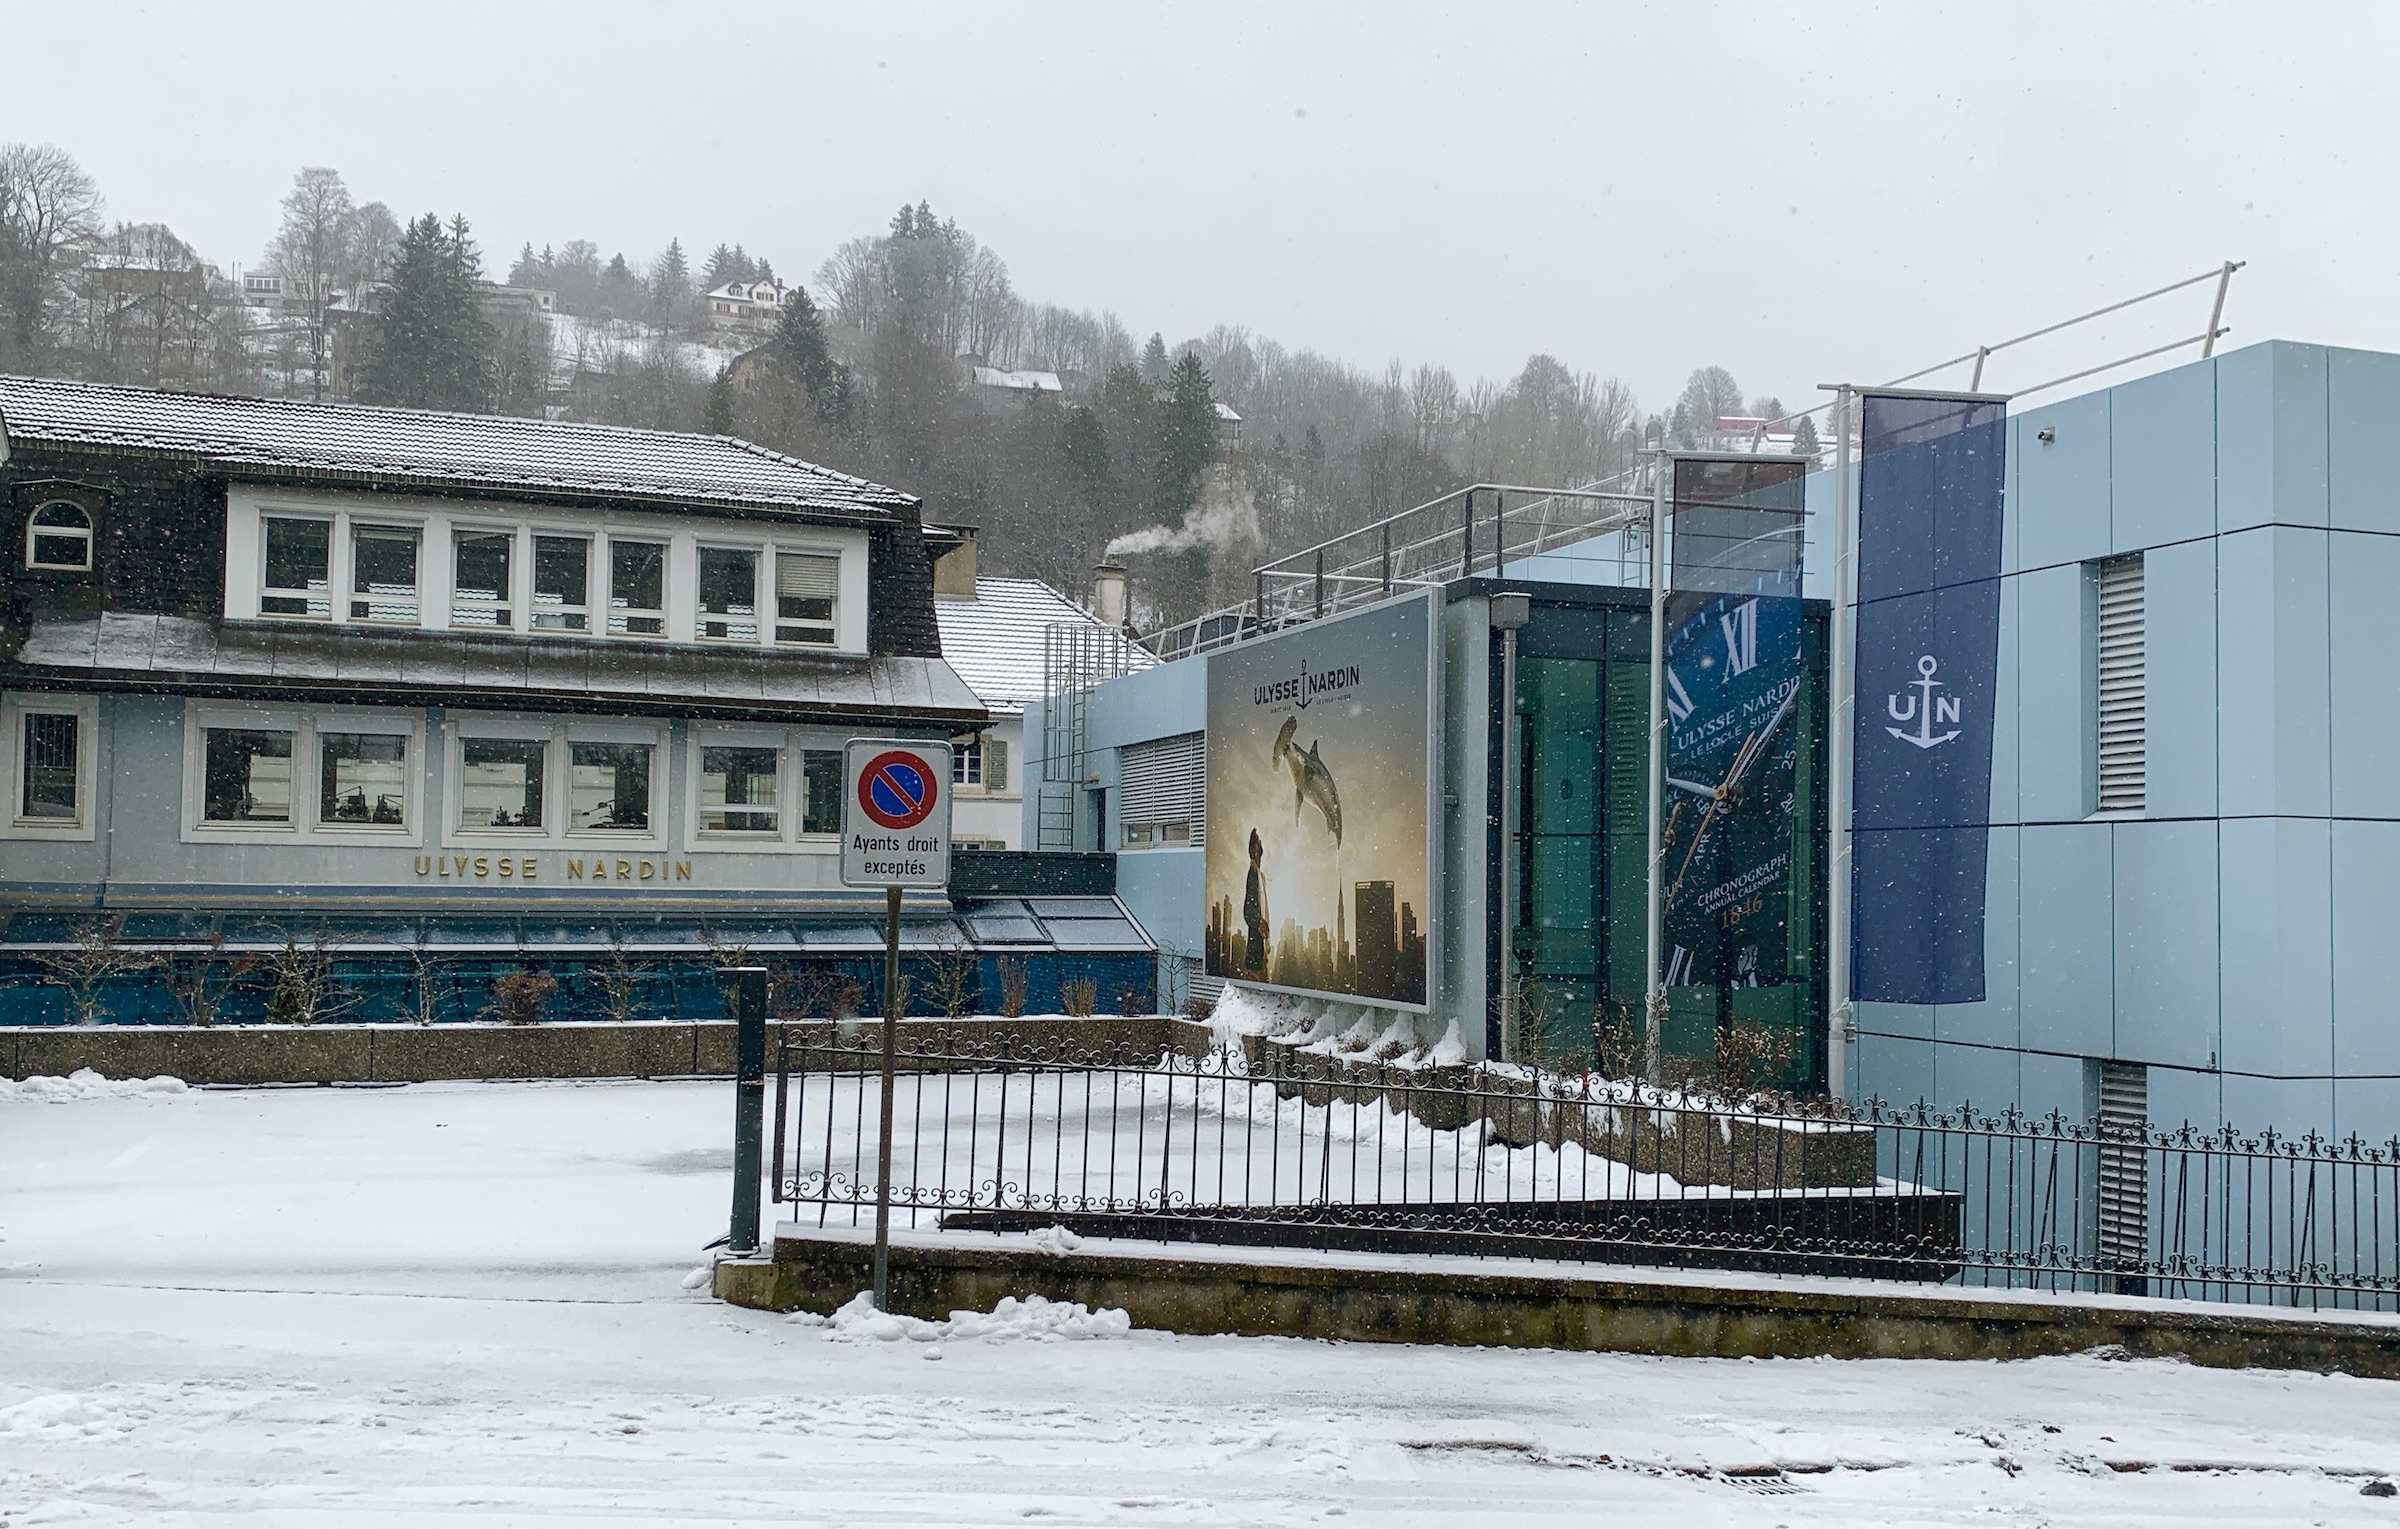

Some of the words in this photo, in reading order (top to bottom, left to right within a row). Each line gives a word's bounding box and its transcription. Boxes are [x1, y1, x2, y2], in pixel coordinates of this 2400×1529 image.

[1254, 678, 1299, 706] ULYSSE
[1308, 664, 1360, 695] NARDIN
[1677, 709, 1736, 750] ULYSSE
[1742, 675, 1800, 718] NARDI
[1781, 749, 1797, 770] 25
[853, 834, 900, 854] Ayants
[907, 835, 939, 852] droit
[1694, 833, 1712, 866] APR
[414, 854, 538, 878] ULYSSE
[567, 858, 693, 880] NARDIN
[864, 859, 926, 878] exceptés
[1697, 853, 1788, 907] CHRONOGRAPH
[1703, 894, 1737, 915] ANNUAL
[1738, 870, 1781, 898] CALENDAR
[1720, 891, 1764, 930] 1846
